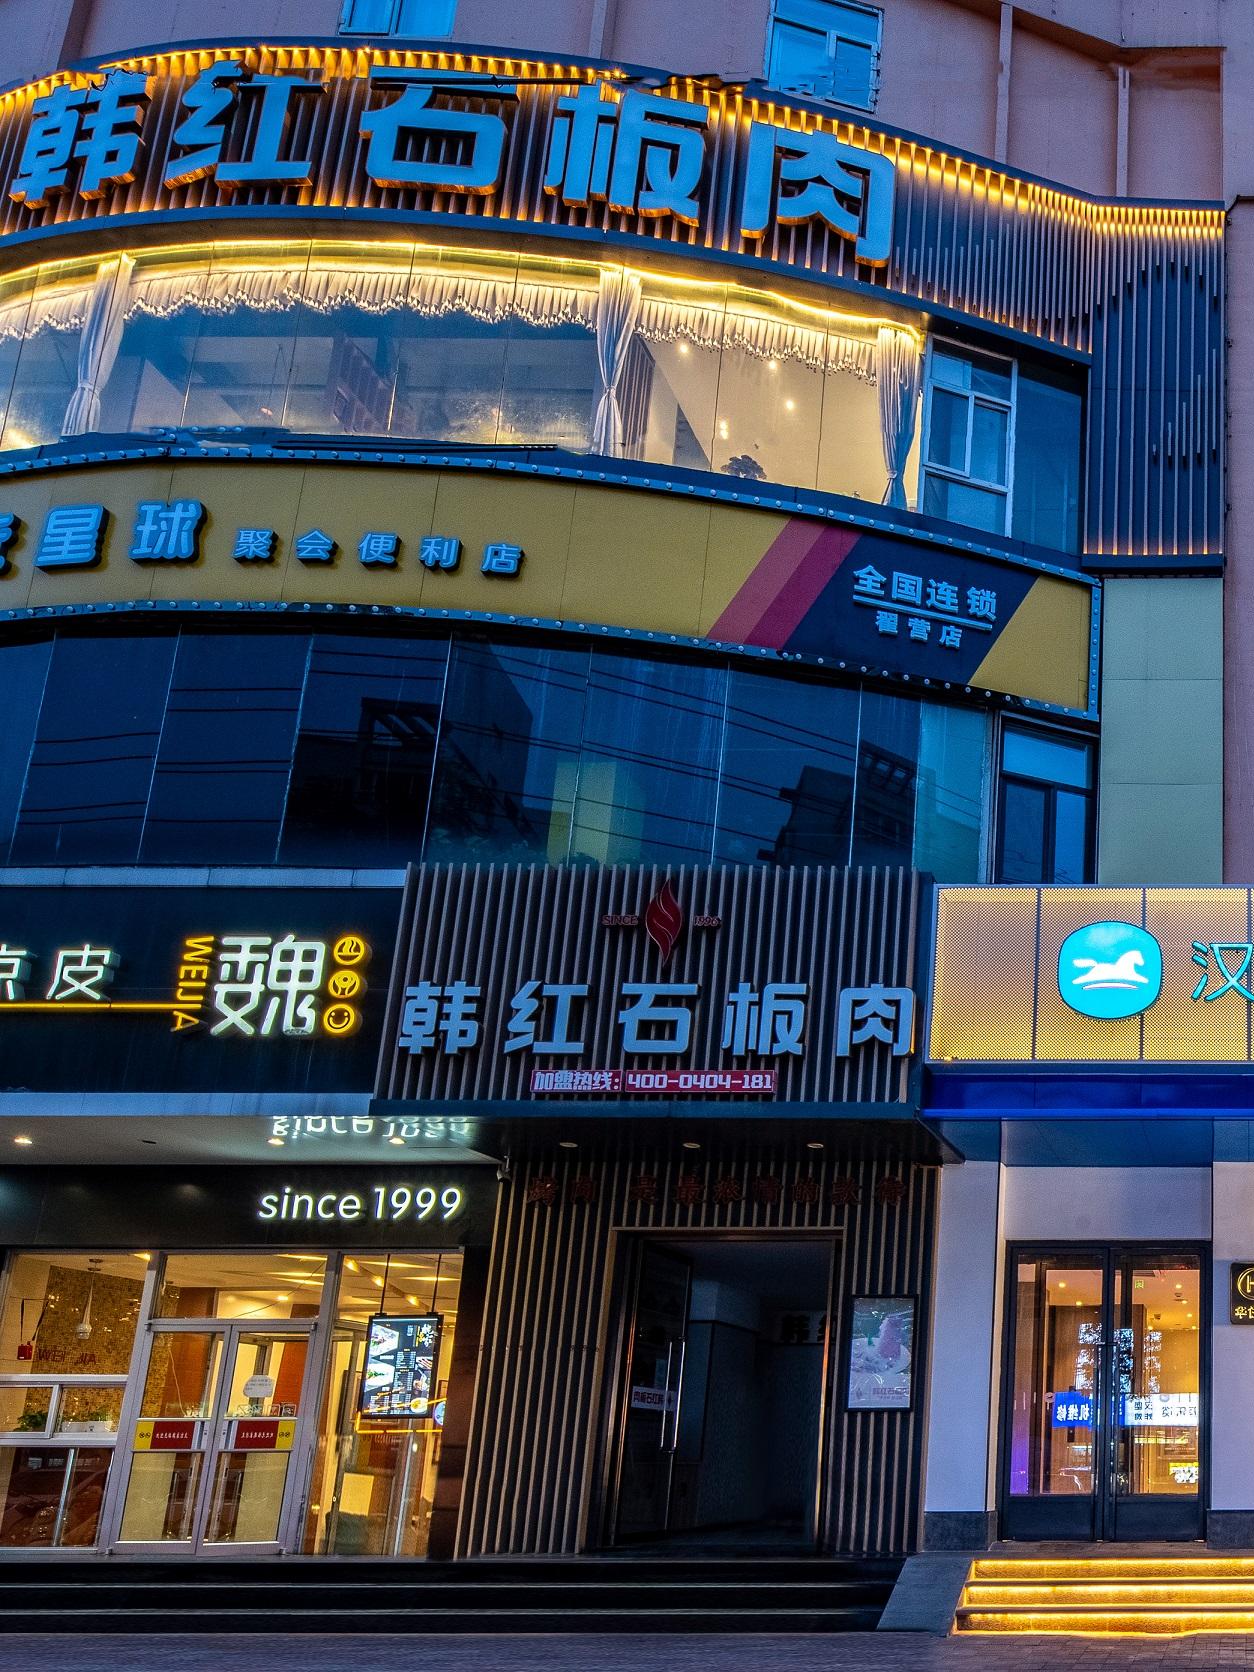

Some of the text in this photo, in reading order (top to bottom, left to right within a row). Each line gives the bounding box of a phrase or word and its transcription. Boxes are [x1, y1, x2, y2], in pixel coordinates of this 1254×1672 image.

[8, 58, 897, 268] 韩红石板肉
[0, 500, 522, 576] 星球 聚会便利店
[853, 564, 997, 622] 全国连锁
[602, 914, 639, 926] SINCE
[399, 981, 916, 1058] 韩红石板肉
[628, 1073, 772, 1089] 400-0404-181
[258, 1186, 463, 1219] since 1999
